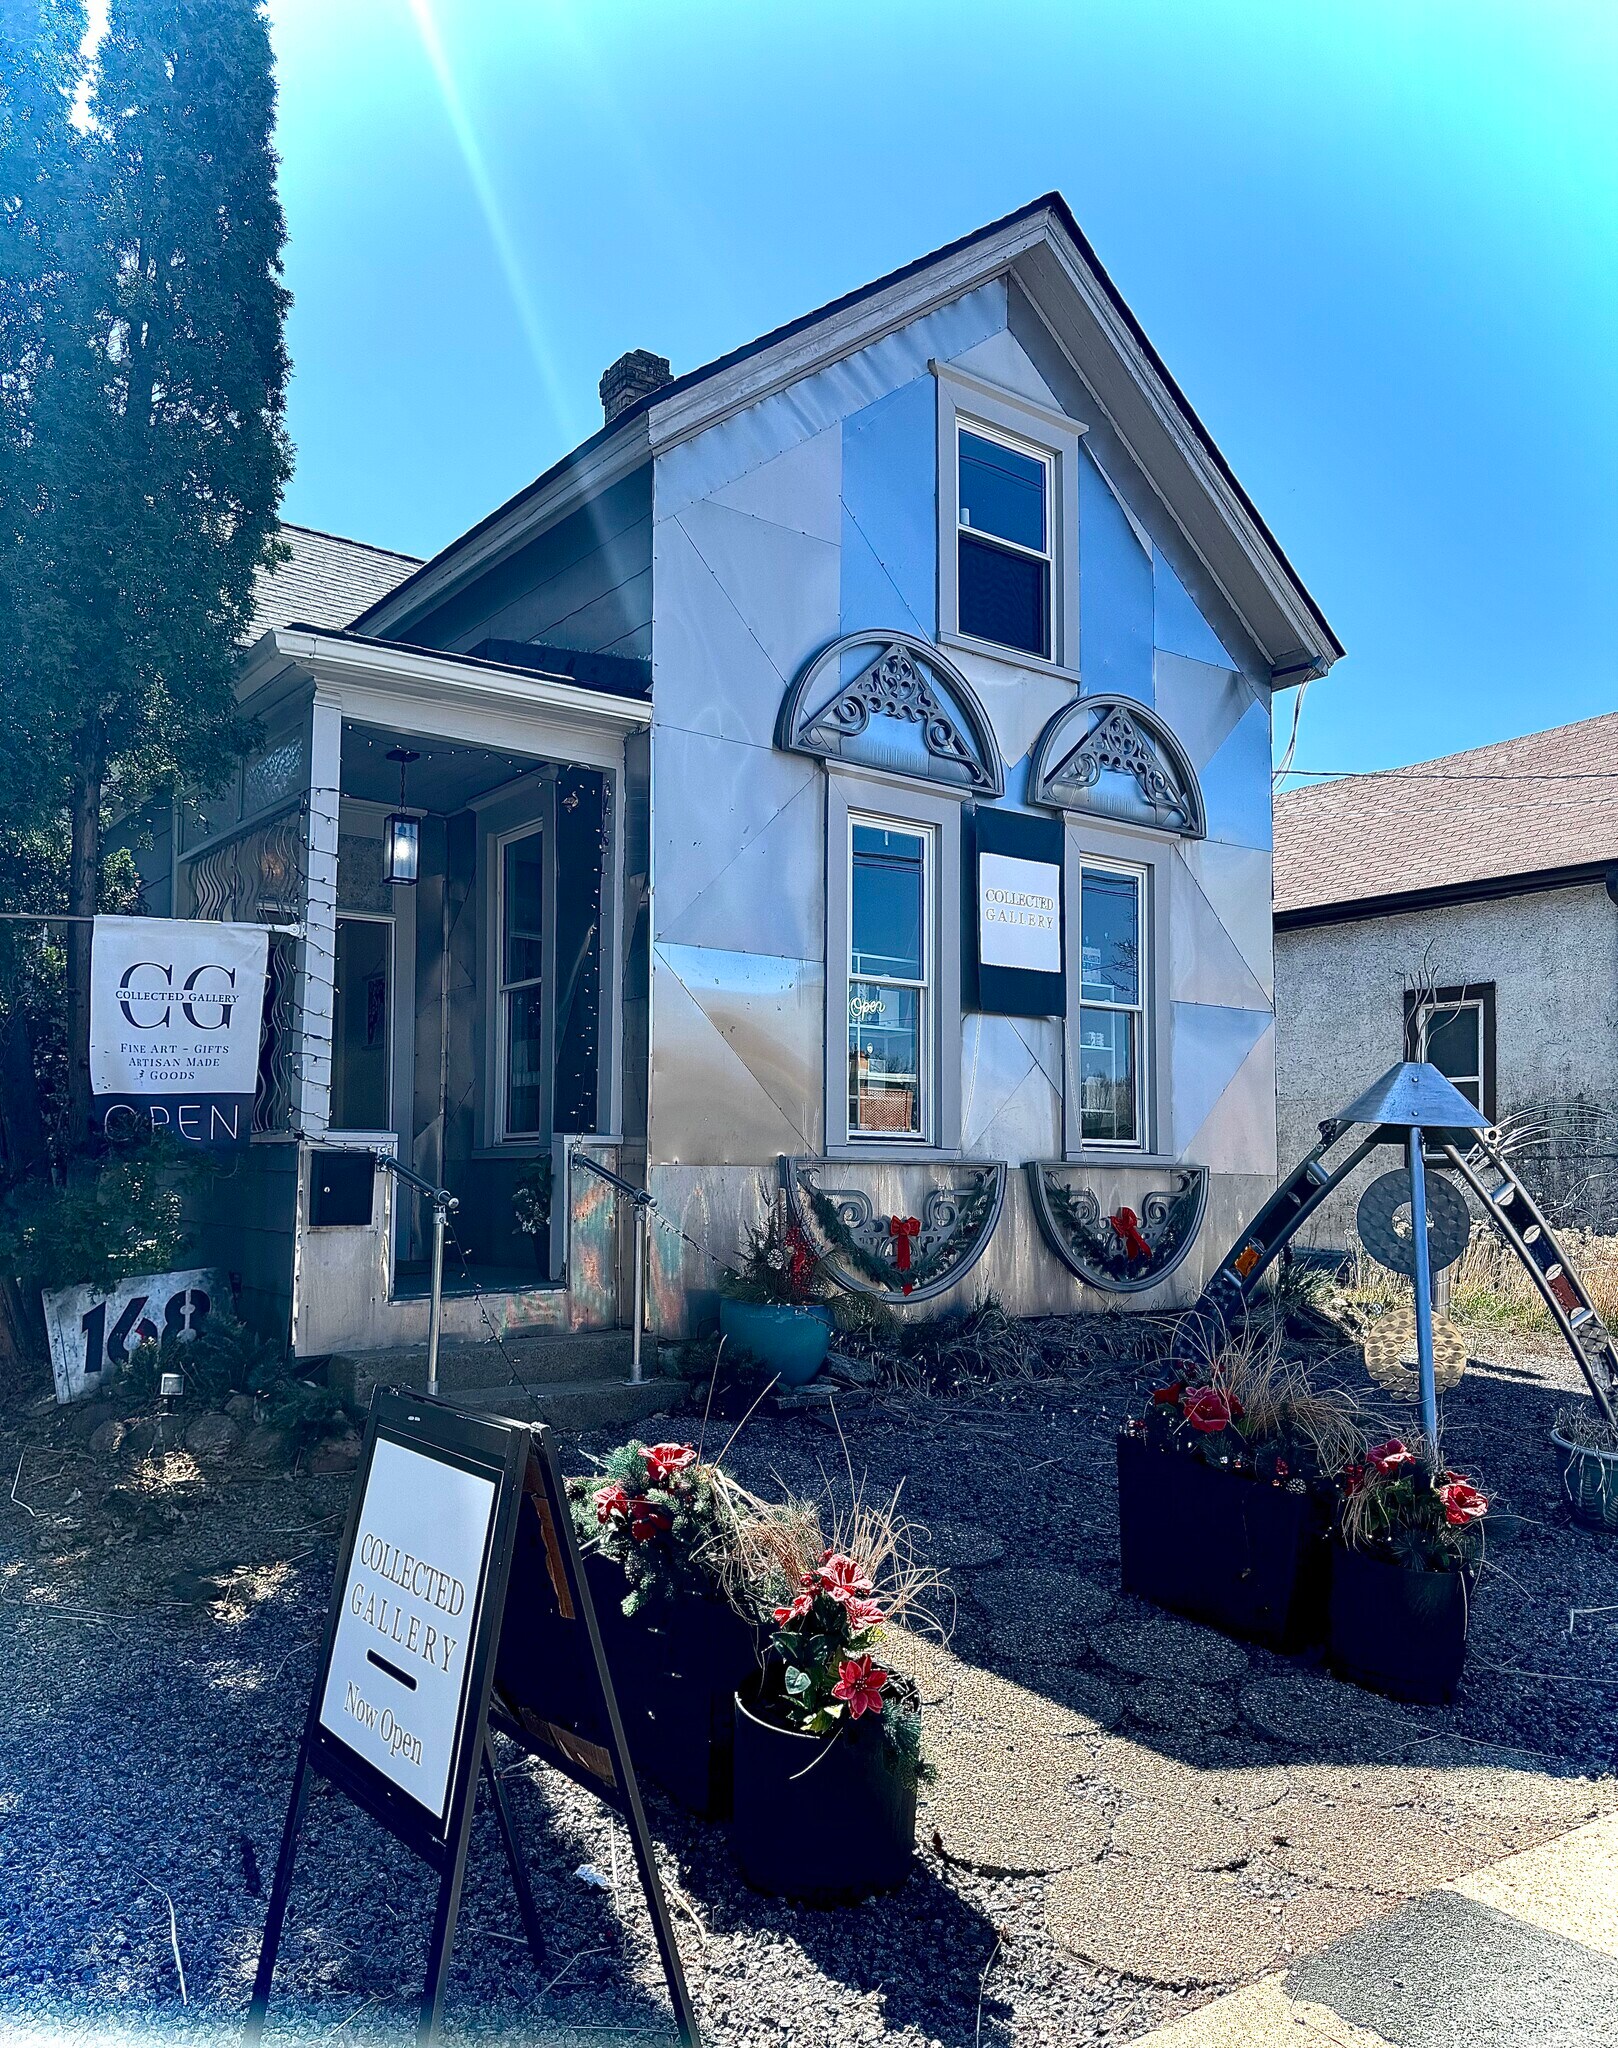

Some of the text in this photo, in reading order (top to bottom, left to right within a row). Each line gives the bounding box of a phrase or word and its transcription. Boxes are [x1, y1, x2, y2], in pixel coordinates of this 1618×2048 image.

[985, 889, 1054, 911] COLLECTED
[985, 908, 1054, 929] GALLERY
[115, 990, 240, 1003] COLLECTED GALLERY
[119, 962, 236, 1030] CG
[850, 997, 886, 1021] Open
[104, 1104, 239, 1142] OPEN
[361, 1533, 465, 1616] COLLECTED
[351, 1583, 457, 1673] GALLERY
